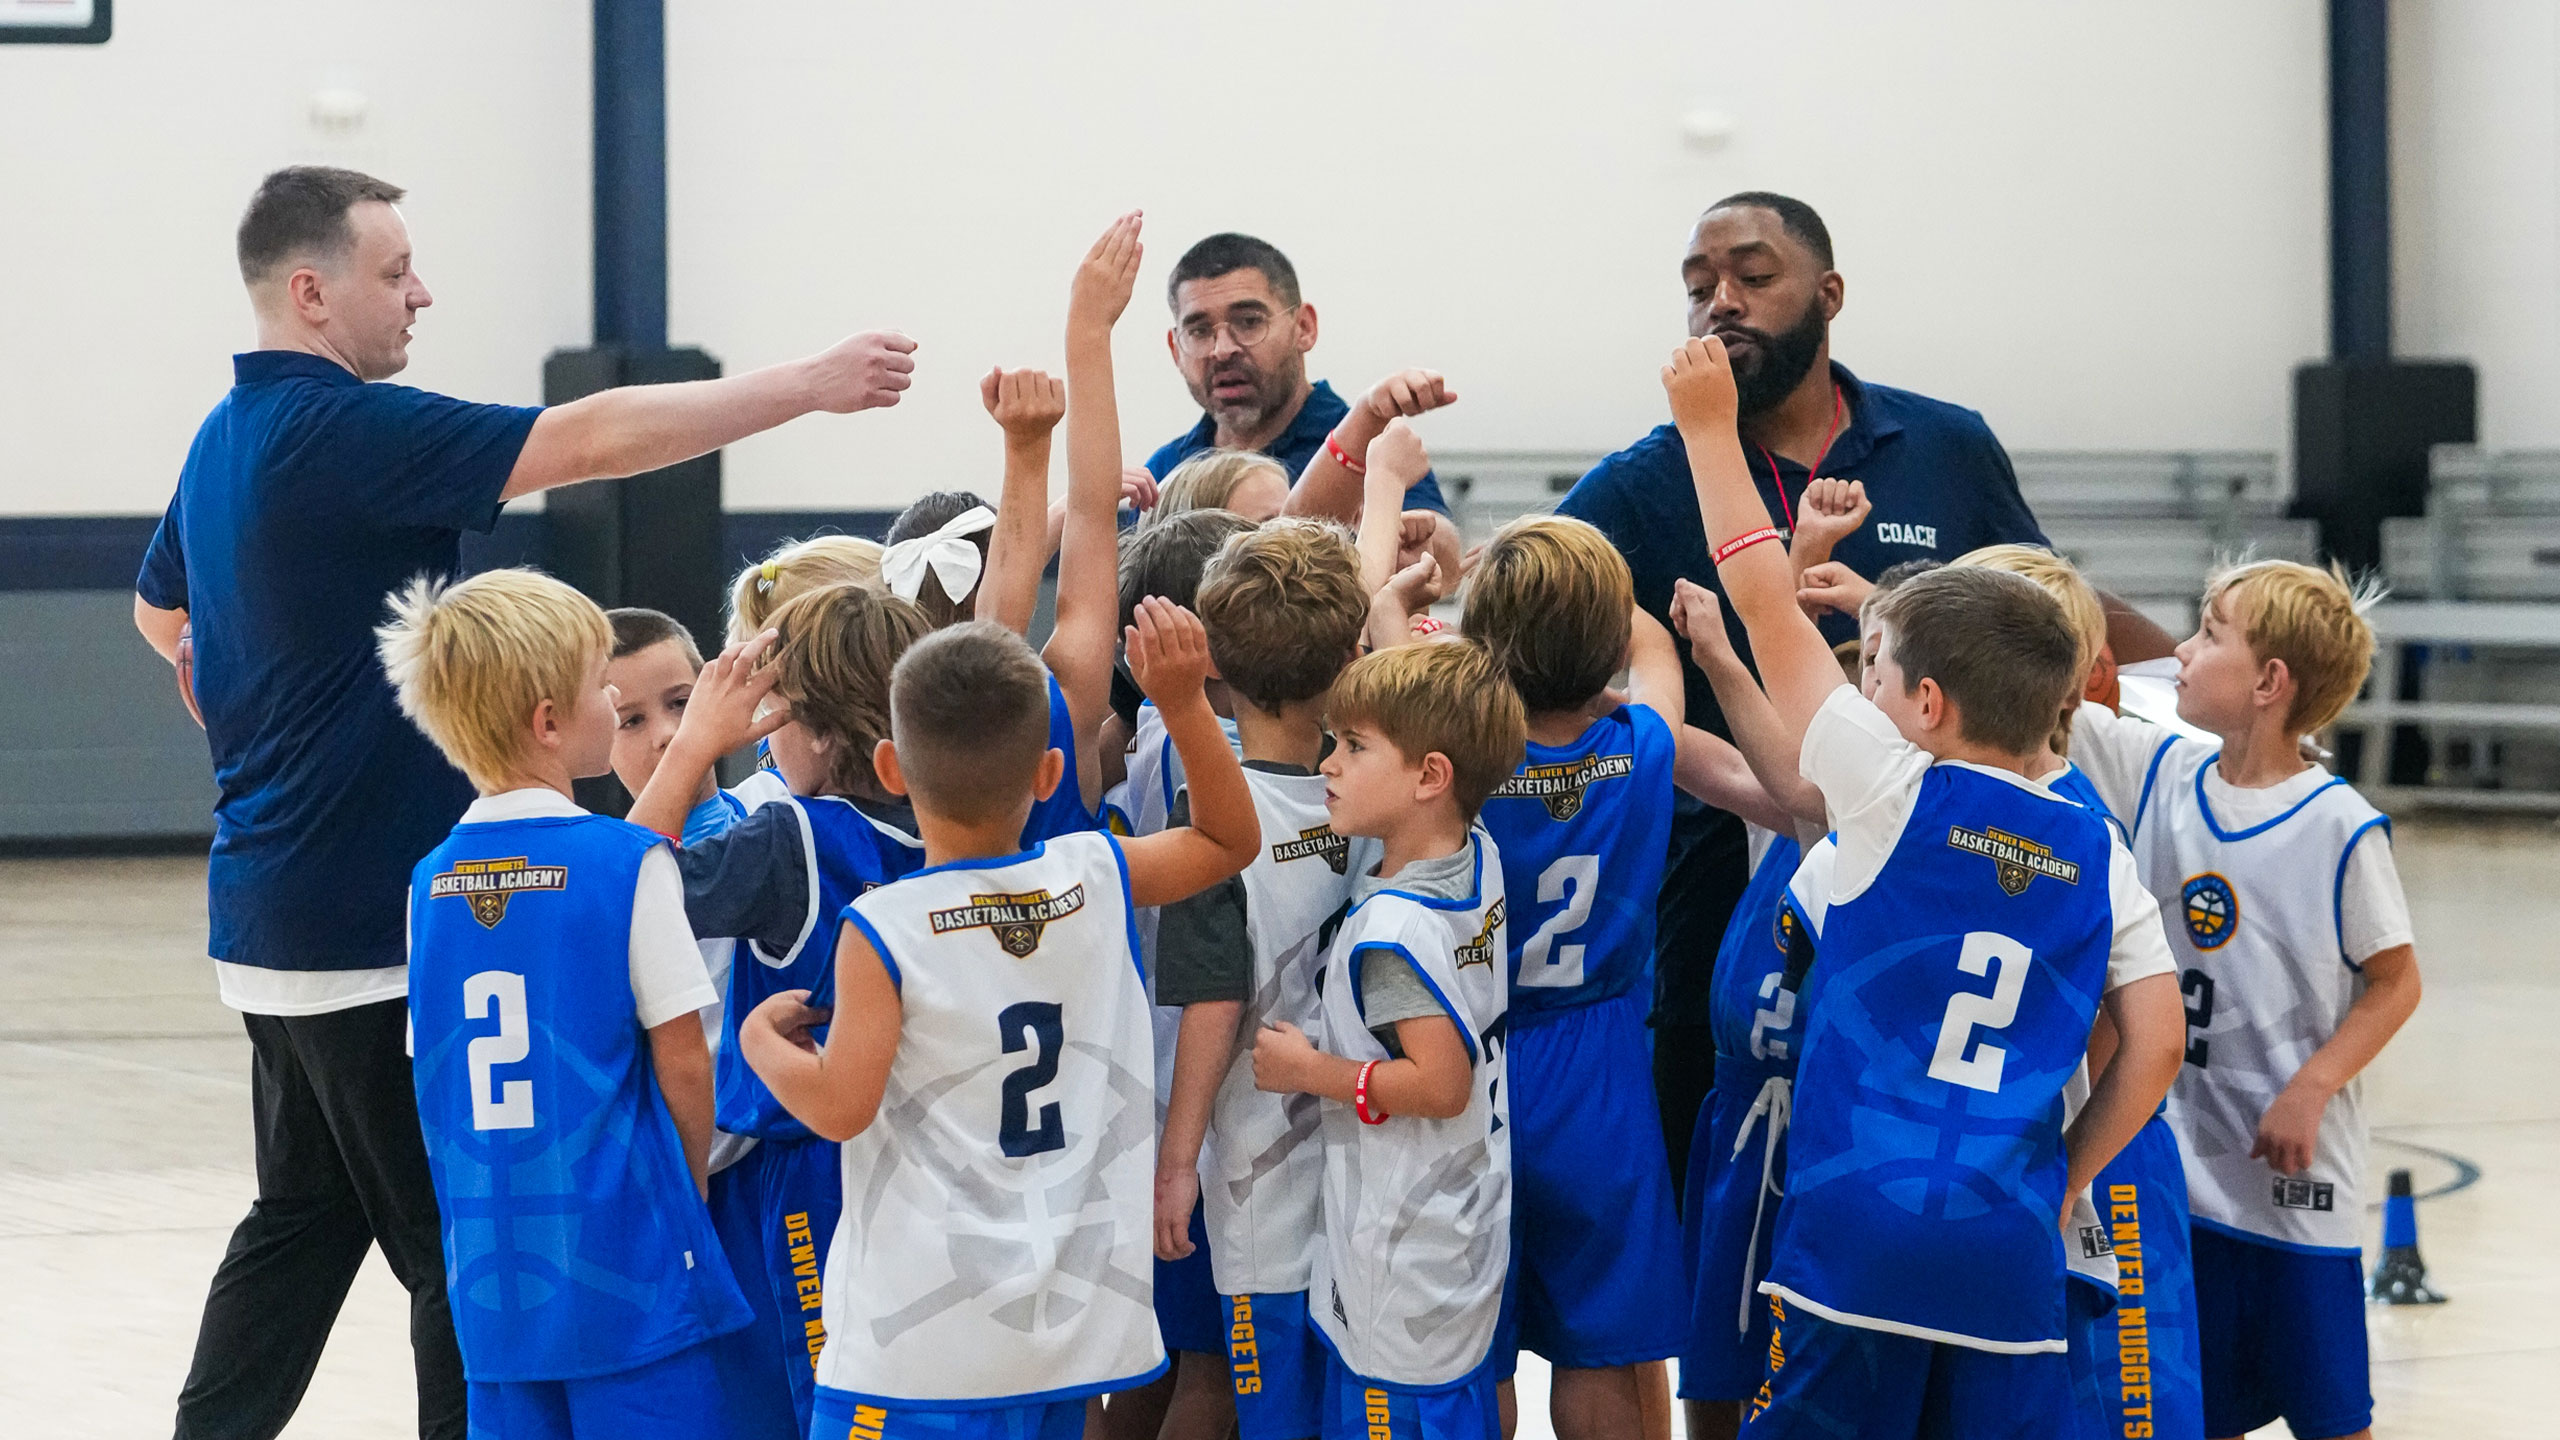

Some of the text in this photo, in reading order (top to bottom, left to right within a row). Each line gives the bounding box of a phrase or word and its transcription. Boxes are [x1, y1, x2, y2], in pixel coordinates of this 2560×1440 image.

[1877, 522, 1937, 548] COACH
[1491, 757, 1632, 795] ASKETBALL ACADEMY
[1528, 767, 1563, 778] DENVER
[1274, 836, 1346, 860] BASKETBALL
[1951, 829, 2077, 881] BASKETBALL ACADEMY
[1988, 830, 2017, 847] DENVER
[432, 870, 563, 895] BASKETBALL ACADEMY
[932, 887, 1083, 931] BASKETBALL ACADEMY
[1516, 854, 1600, 988] 2
[1751, 971, 1797, 1061] 2
[1927, 931, 2033, 1093] 2
[2181, 968, 2215, 1069] 2
[463, 970, 535, 1131] 2
[998, 1001, 1065, 1157] 2
[784, 1211, 822, 1311] DENVER
[2109, 1184, 2154, 1440] DENVER NUGGETS
